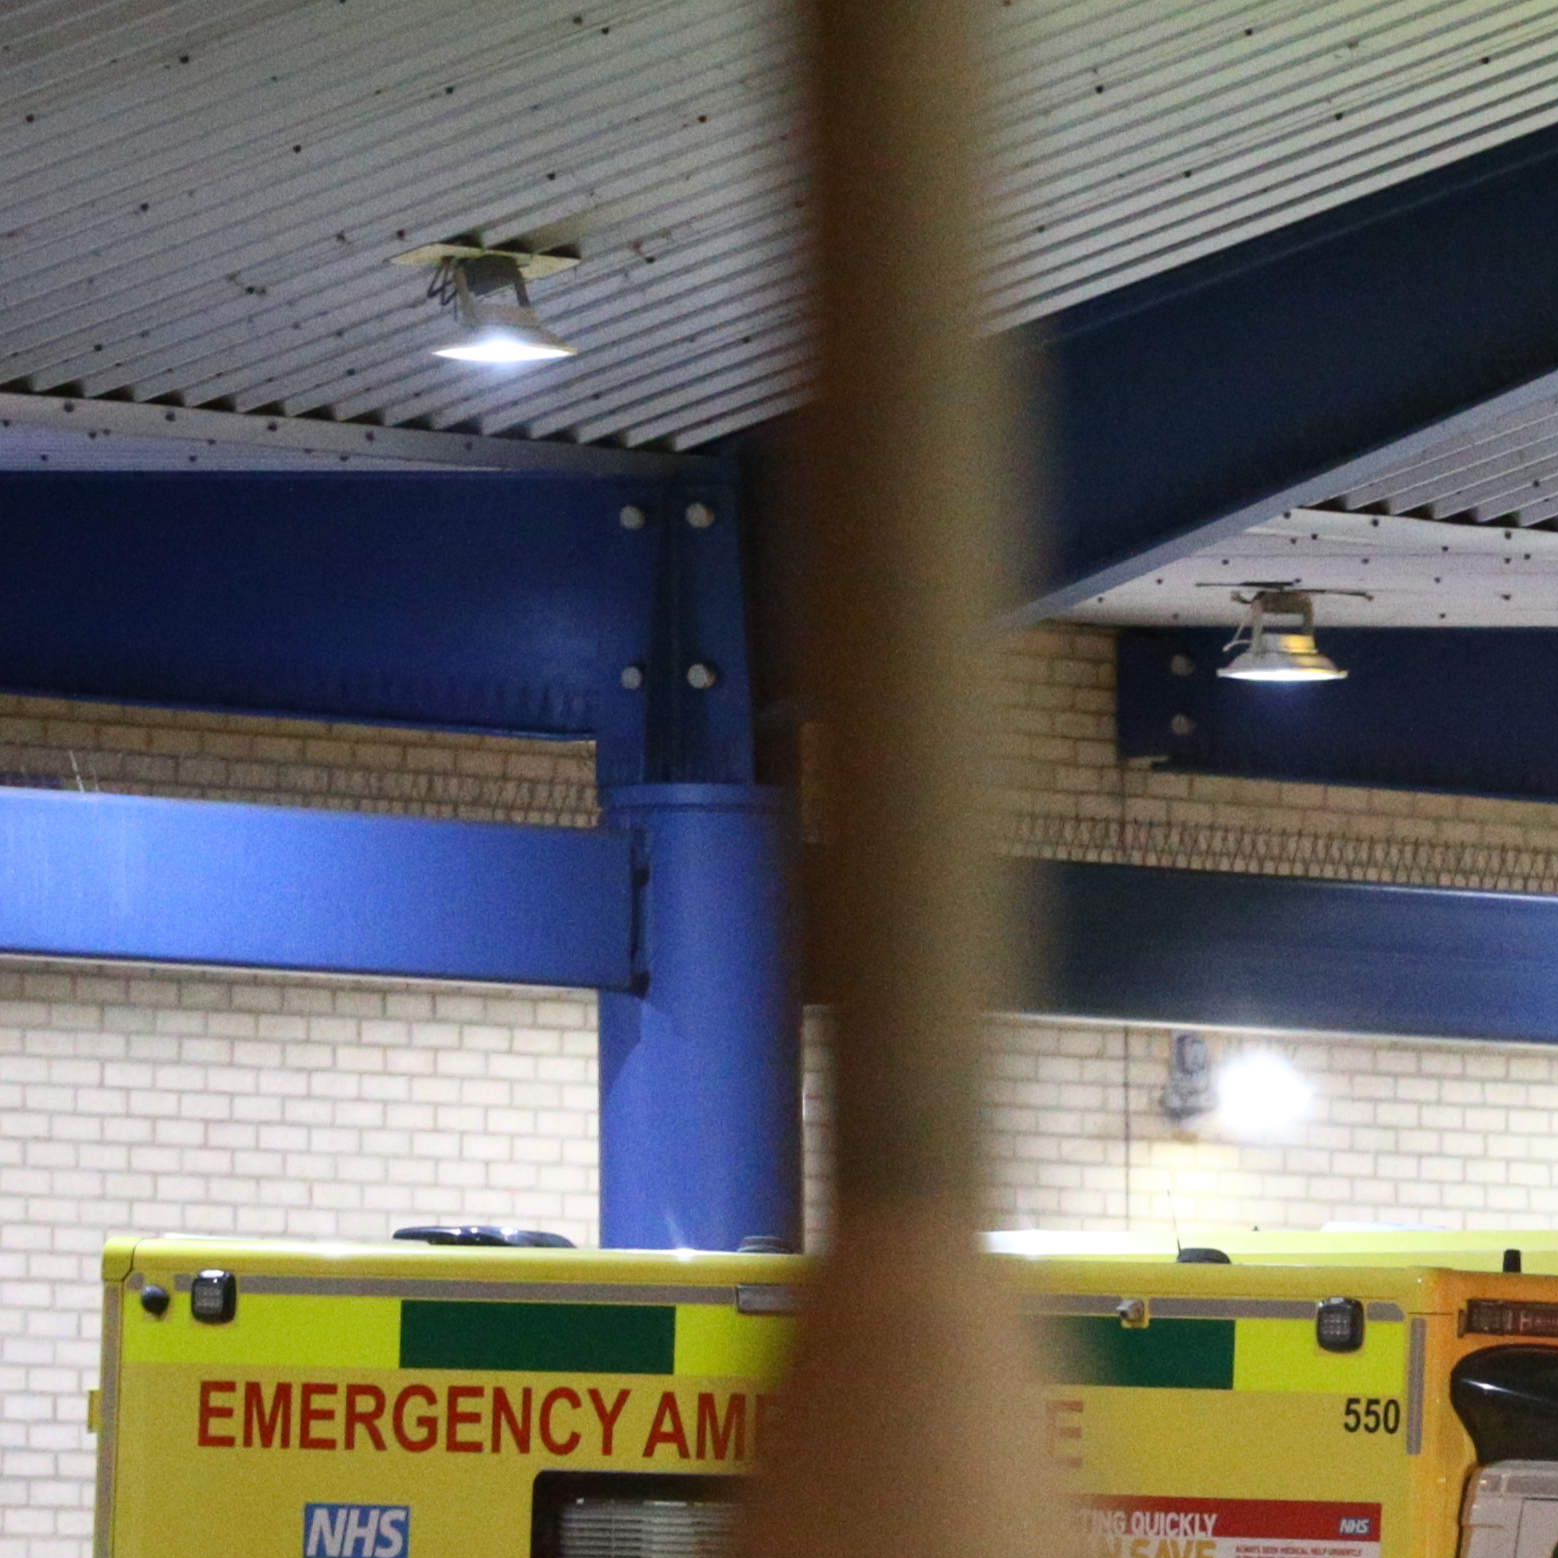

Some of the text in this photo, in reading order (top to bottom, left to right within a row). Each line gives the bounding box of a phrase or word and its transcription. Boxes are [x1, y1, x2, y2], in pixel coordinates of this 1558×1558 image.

[198, 1378, 632, 1457] EMERGENCY
[1343, 1397, 1401, 1435] 550
[1130, 1511, 1218, 1537] QUICKLY
[1339, 1517, 1370, 1534] NHS
